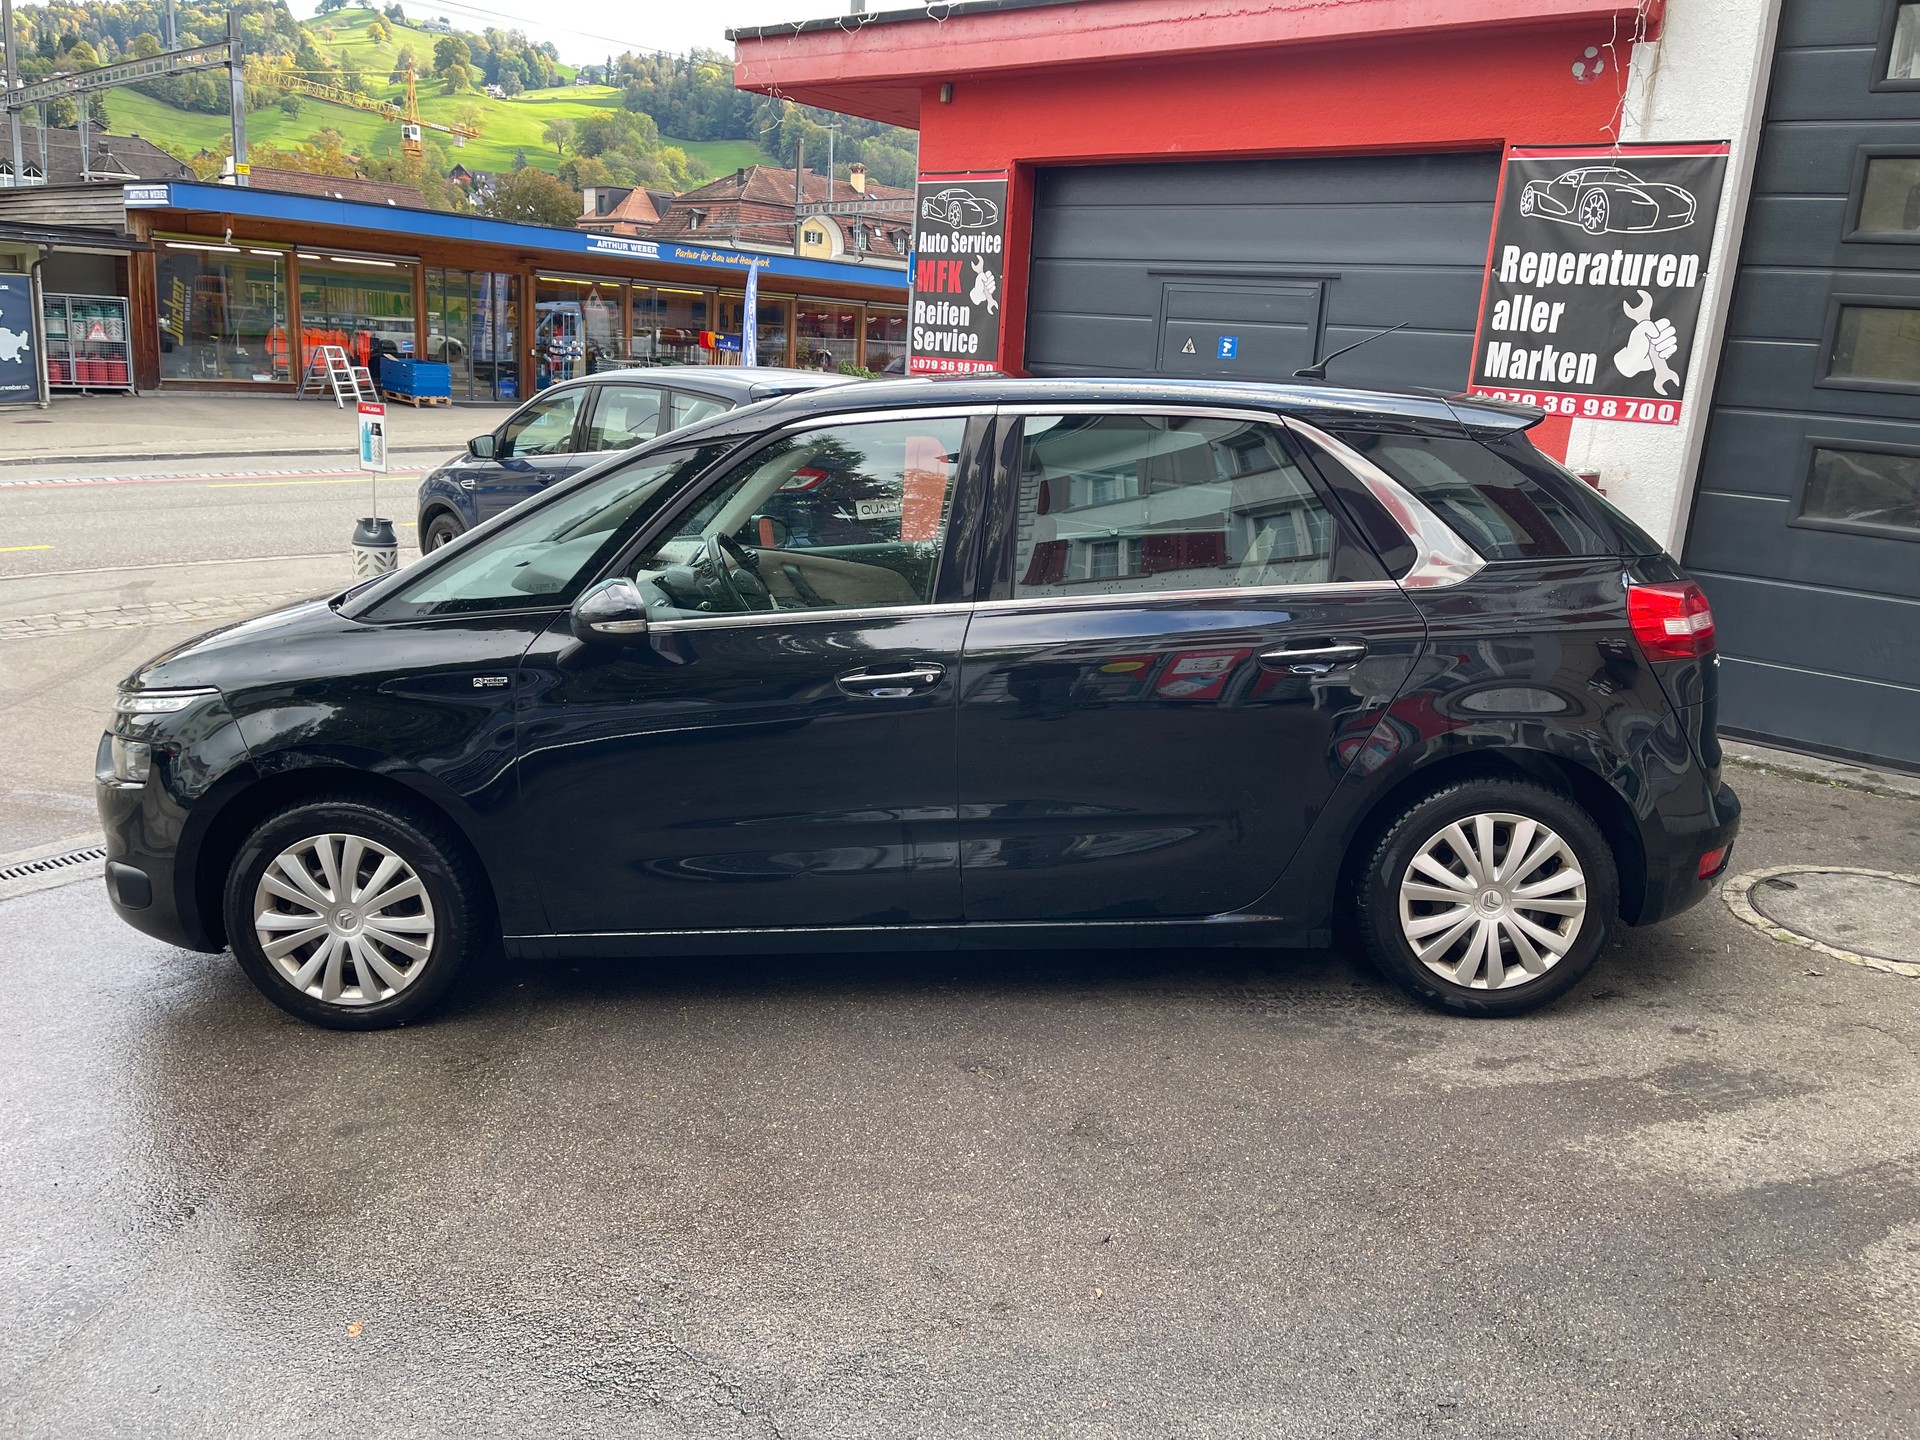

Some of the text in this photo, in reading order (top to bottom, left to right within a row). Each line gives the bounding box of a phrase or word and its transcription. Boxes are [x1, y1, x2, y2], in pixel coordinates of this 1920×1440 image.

[129, 190, 168, 199] ARTHUR WEBER
[596, 240, 658, 254] ARTHUR WEBER
[918, 231, 1001, 254] Auto Service
[675, 248, 700, 259] Partner
[700, 250, 710, 261] für
[711, 252, 725, 263] Bau
[725, 254, 740, 264] und
[1499, 244, 1700, 288] Reperaturen
[916, 259, 963, 293] MFK
[914, 300, 970, 326] Reifen
[1491, 294, 1566, 334] aller
[913, 326, 978, 354] Service
[918, 359, 994, 373] 079 36 98 700
[1483, 341, 1598, 385] Marken
[1543, 395, 1577, 414] 36
[1583, 398, 1617, 418] 98
[1625, 402, 1675, 422] 700
